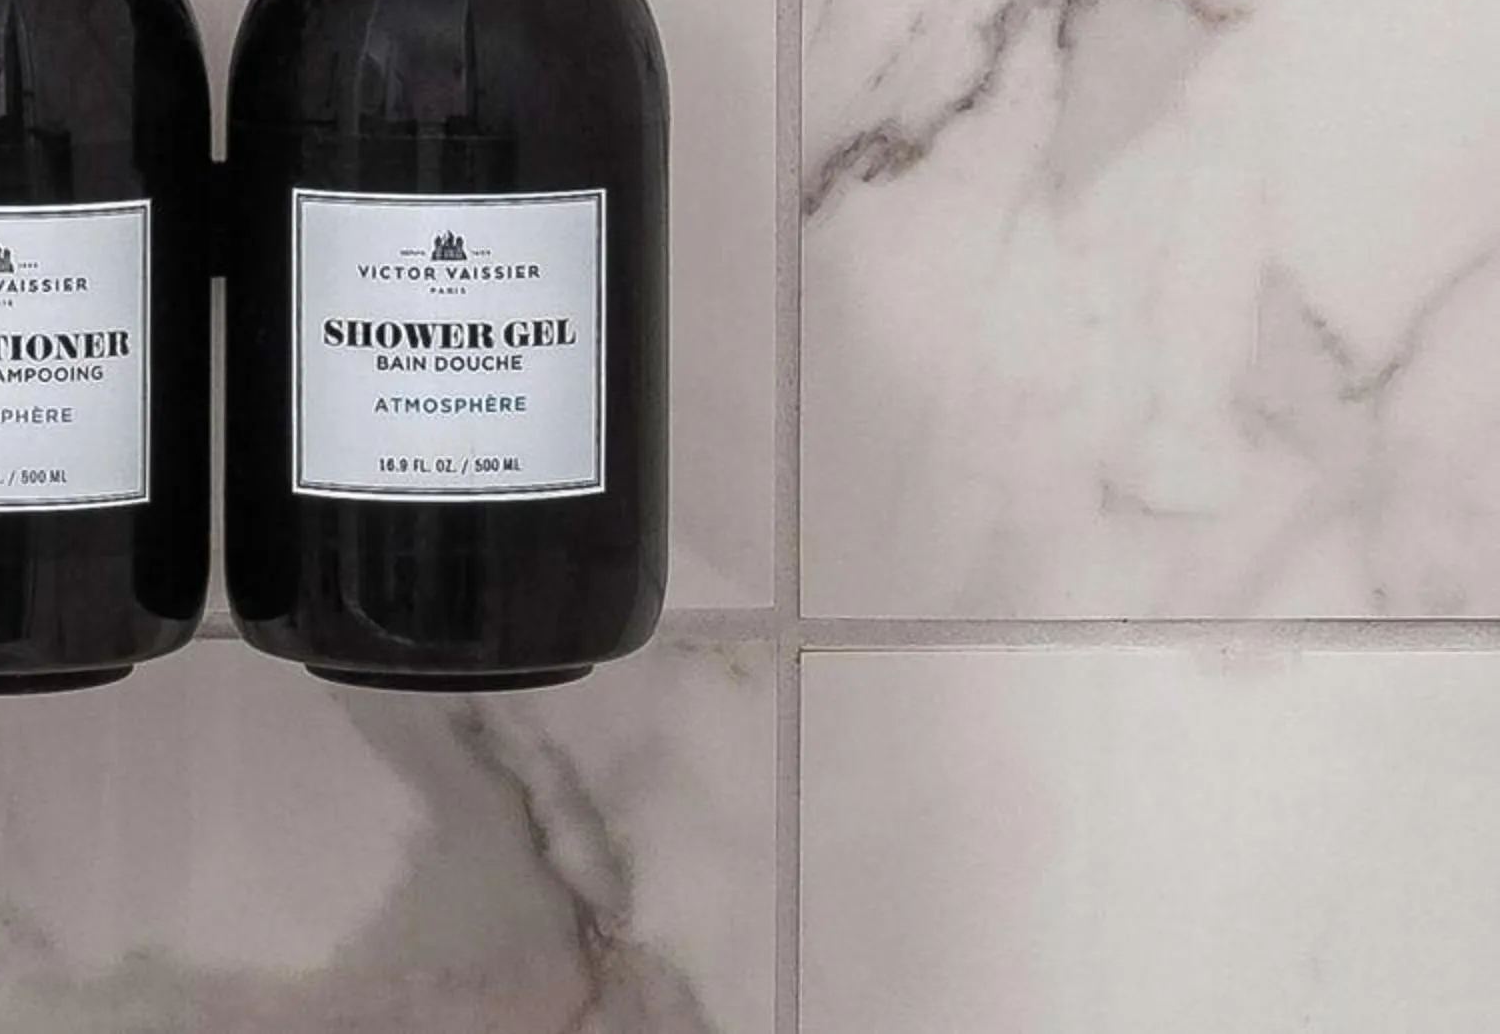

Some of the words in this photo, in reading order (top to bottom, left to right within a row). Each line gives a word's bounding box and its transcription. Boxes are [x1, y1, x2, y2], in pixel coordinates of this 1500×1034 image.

[357, 265, 437, 280] VICTOR
[445, 265, 541, 280] VAISSIER
[323, 319, 495, 349] SHOWER
[503, 318, 577, 347] GEL
[376, 355, 427, 371] BAIN
[434, 355, 523, 372] DOUCHE
[374, 394, 527, 413] ATMOSPHÈRE
[461, 457, 469, 475] /
[474, 457, 500, 472] 500
[503, 457, 522, 471] ML
[7, 469, 16, 486] /
[21, 469, 46, 484] 500
[49, 469, 67, 483] ML
